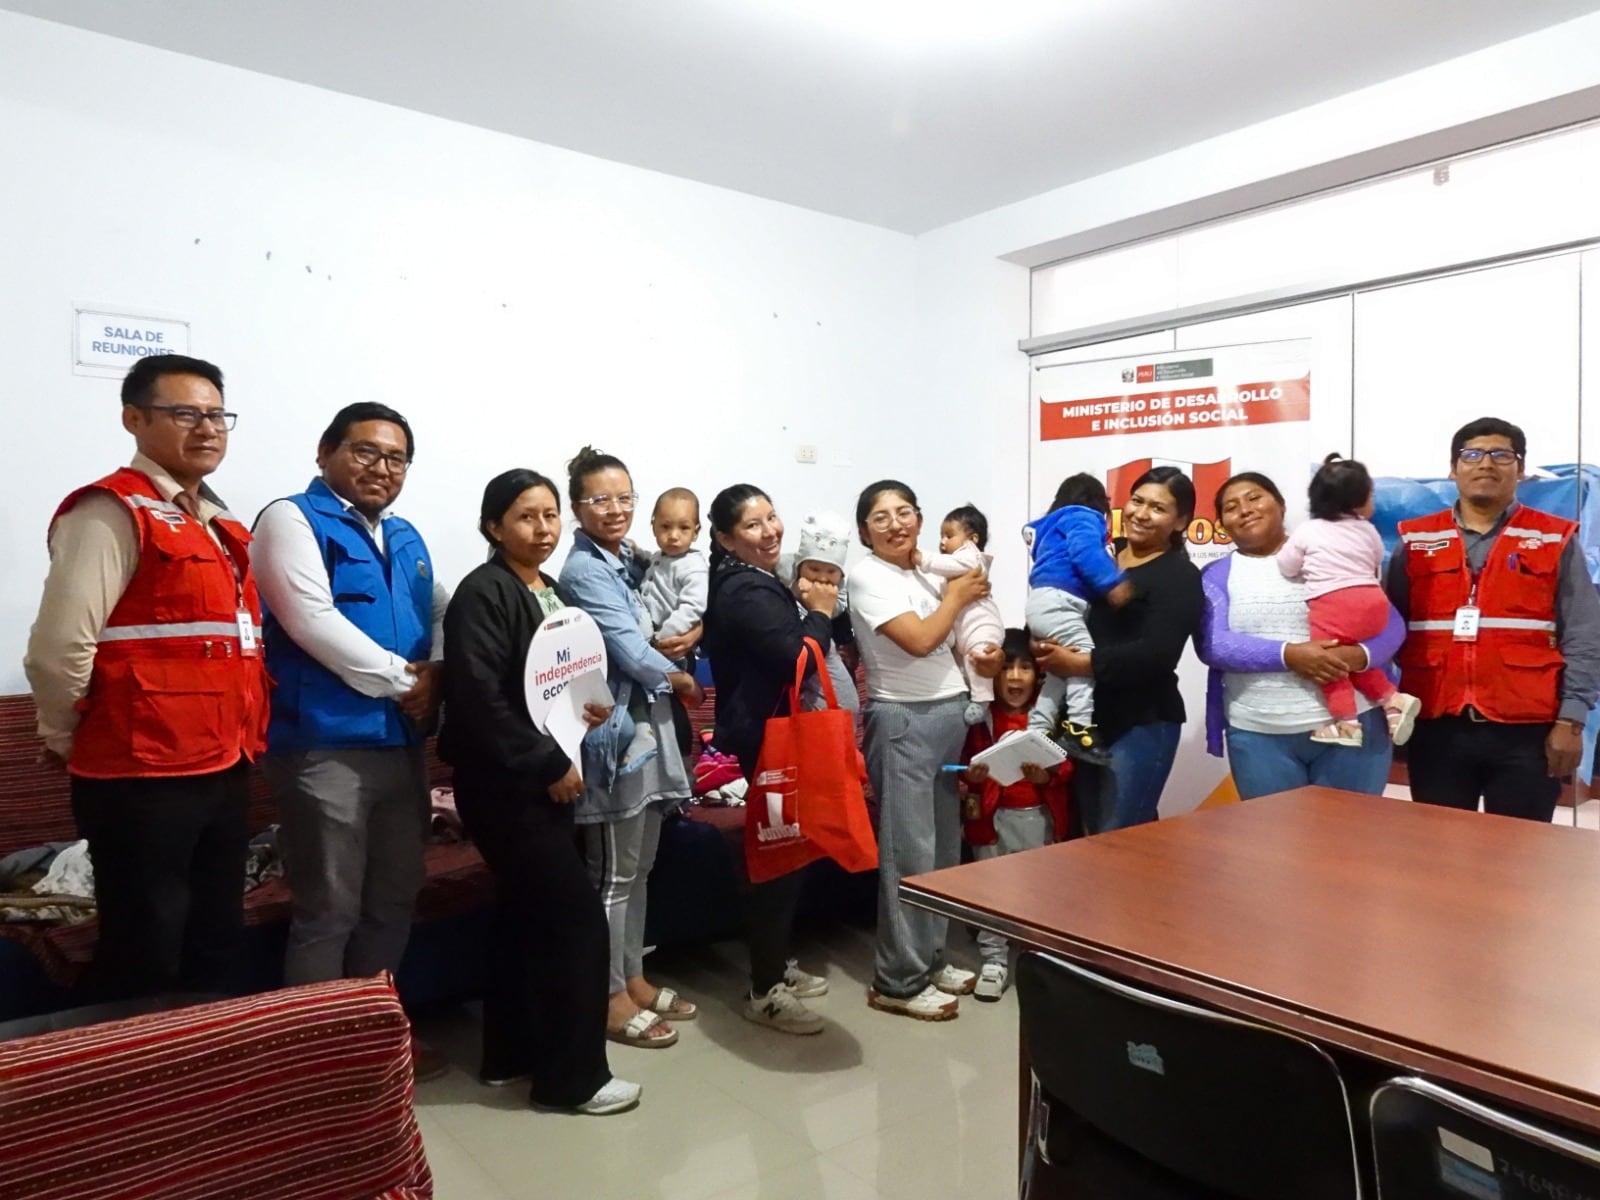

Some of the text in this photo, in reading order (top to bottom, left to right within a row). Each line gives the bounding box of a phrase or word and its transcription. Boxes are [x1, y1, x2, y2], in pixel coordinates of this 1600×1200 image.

[104, 326, 164, 343] SALA DE
[1062, 399, 1146, 418] MINISTERIO
[1150, 397, 1171, 410] DE
[1091, 408, 1248, 432] E INCLUSIÓN SOCIAL
[556, 647, 571, 665] Mi
[535, 650, 602, 686] independencia
